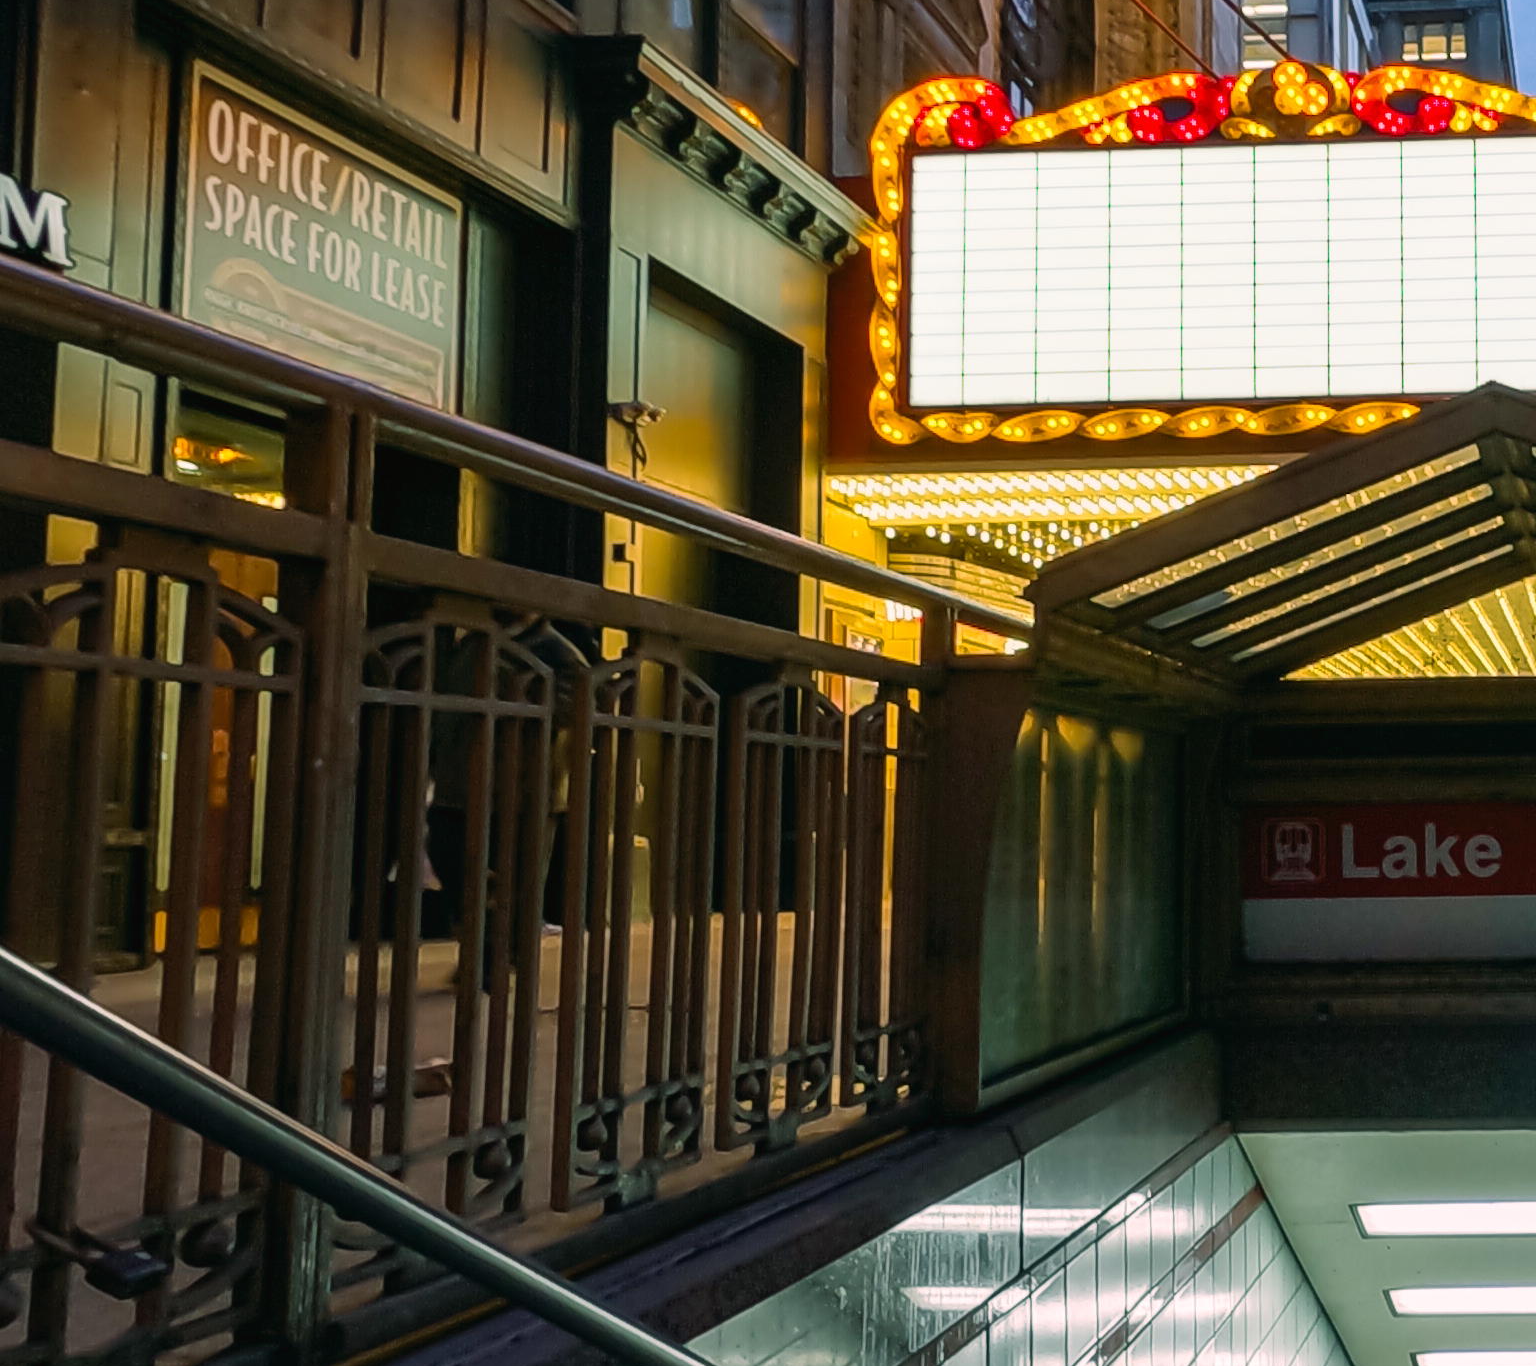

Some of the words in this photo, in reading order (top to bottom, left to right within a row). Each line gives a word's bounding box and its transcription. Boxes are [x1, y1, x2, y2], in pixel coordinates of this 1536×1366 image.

[205, 176, 298, 266] SPACE
[307, 222, 362, 293] FOR
[370, 251, 446, 329] LEASE
[207, 99, 447, 270] OFFICE/RETAIL
[1341, 822, 1502, 879] Lake
